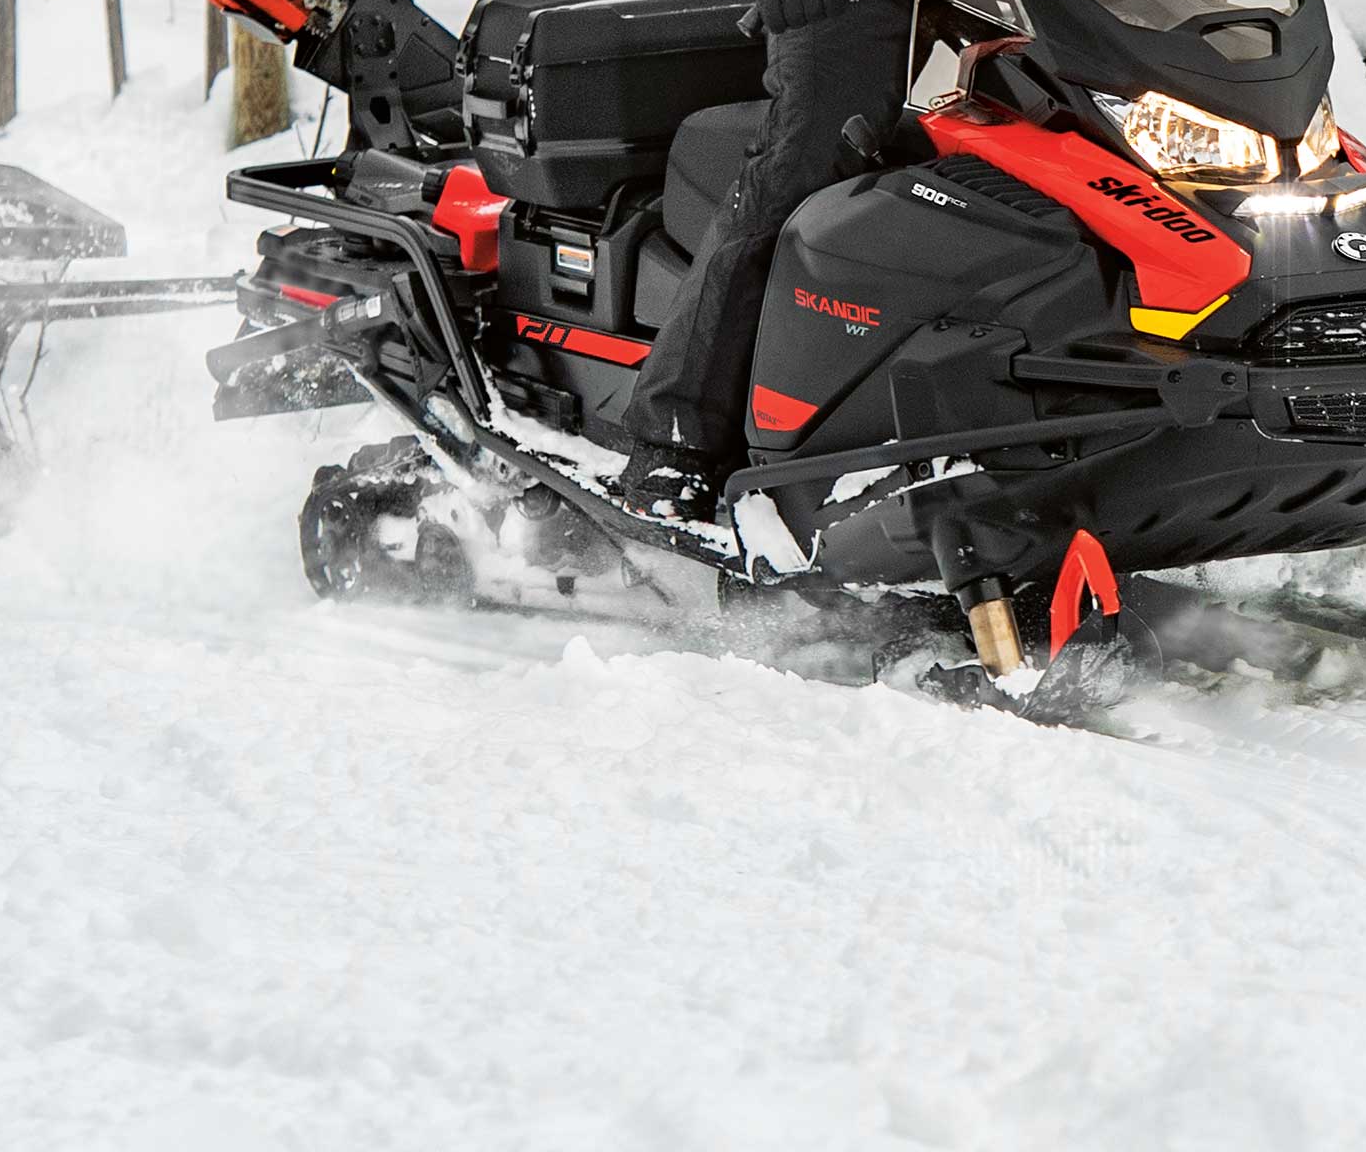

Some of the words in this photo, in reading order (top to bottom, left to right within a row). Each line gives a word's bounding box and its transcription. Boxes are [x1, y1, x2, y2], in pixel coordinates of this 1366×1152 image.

[911, 183, 948, 206] 900
[1087, 177, 1217, 243] ski-doo
[794, 288, 881, 327] SKANDIC
[845, 323, 870, 336] WT
